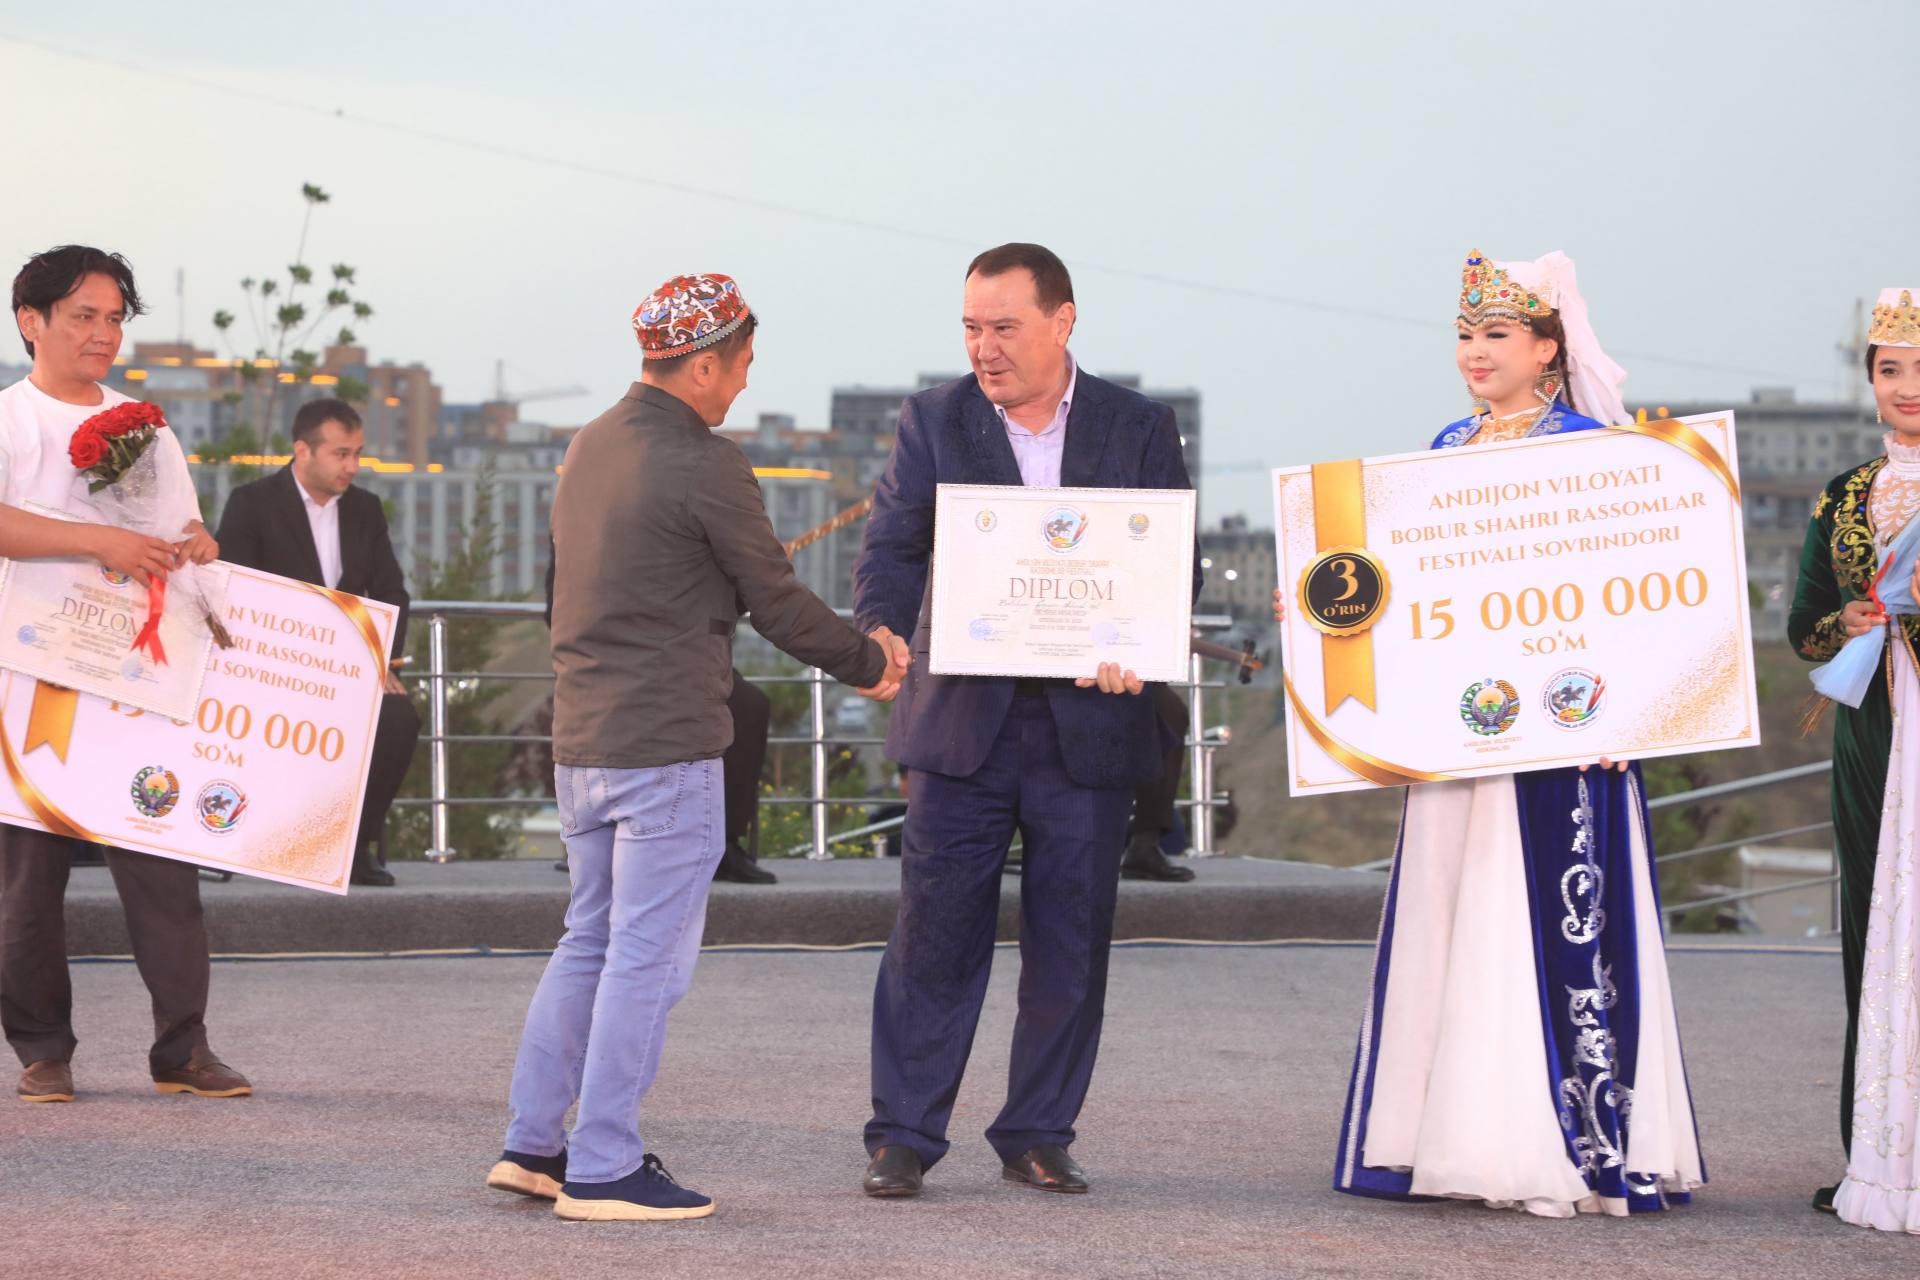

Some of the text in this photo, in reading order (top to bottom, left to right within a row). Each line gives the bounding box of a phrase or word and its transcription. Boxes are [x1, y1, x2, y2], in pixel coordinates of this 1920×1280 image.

[1428, 464, 1662, 511] ANDIJON VILOYATI
[1391, 491, 1707, 545] BOBUR SHAHRI RASSOMLAR
[1419, 525, 1681, 572] FESTIVALI SOVRINDORI
[1009, 577, 1114, 601] DIPLOM
[1329, 558, 1359, 602] 3
[1407, 567, 1709, 641] 15 000 000
[250, 608, 337, 646] VILOYATI
[223, 658, 336, 701] SOVRINDORI
[255, 641, 362, 679] RASSOMLAR
[263, 713, 345, 763] 000
